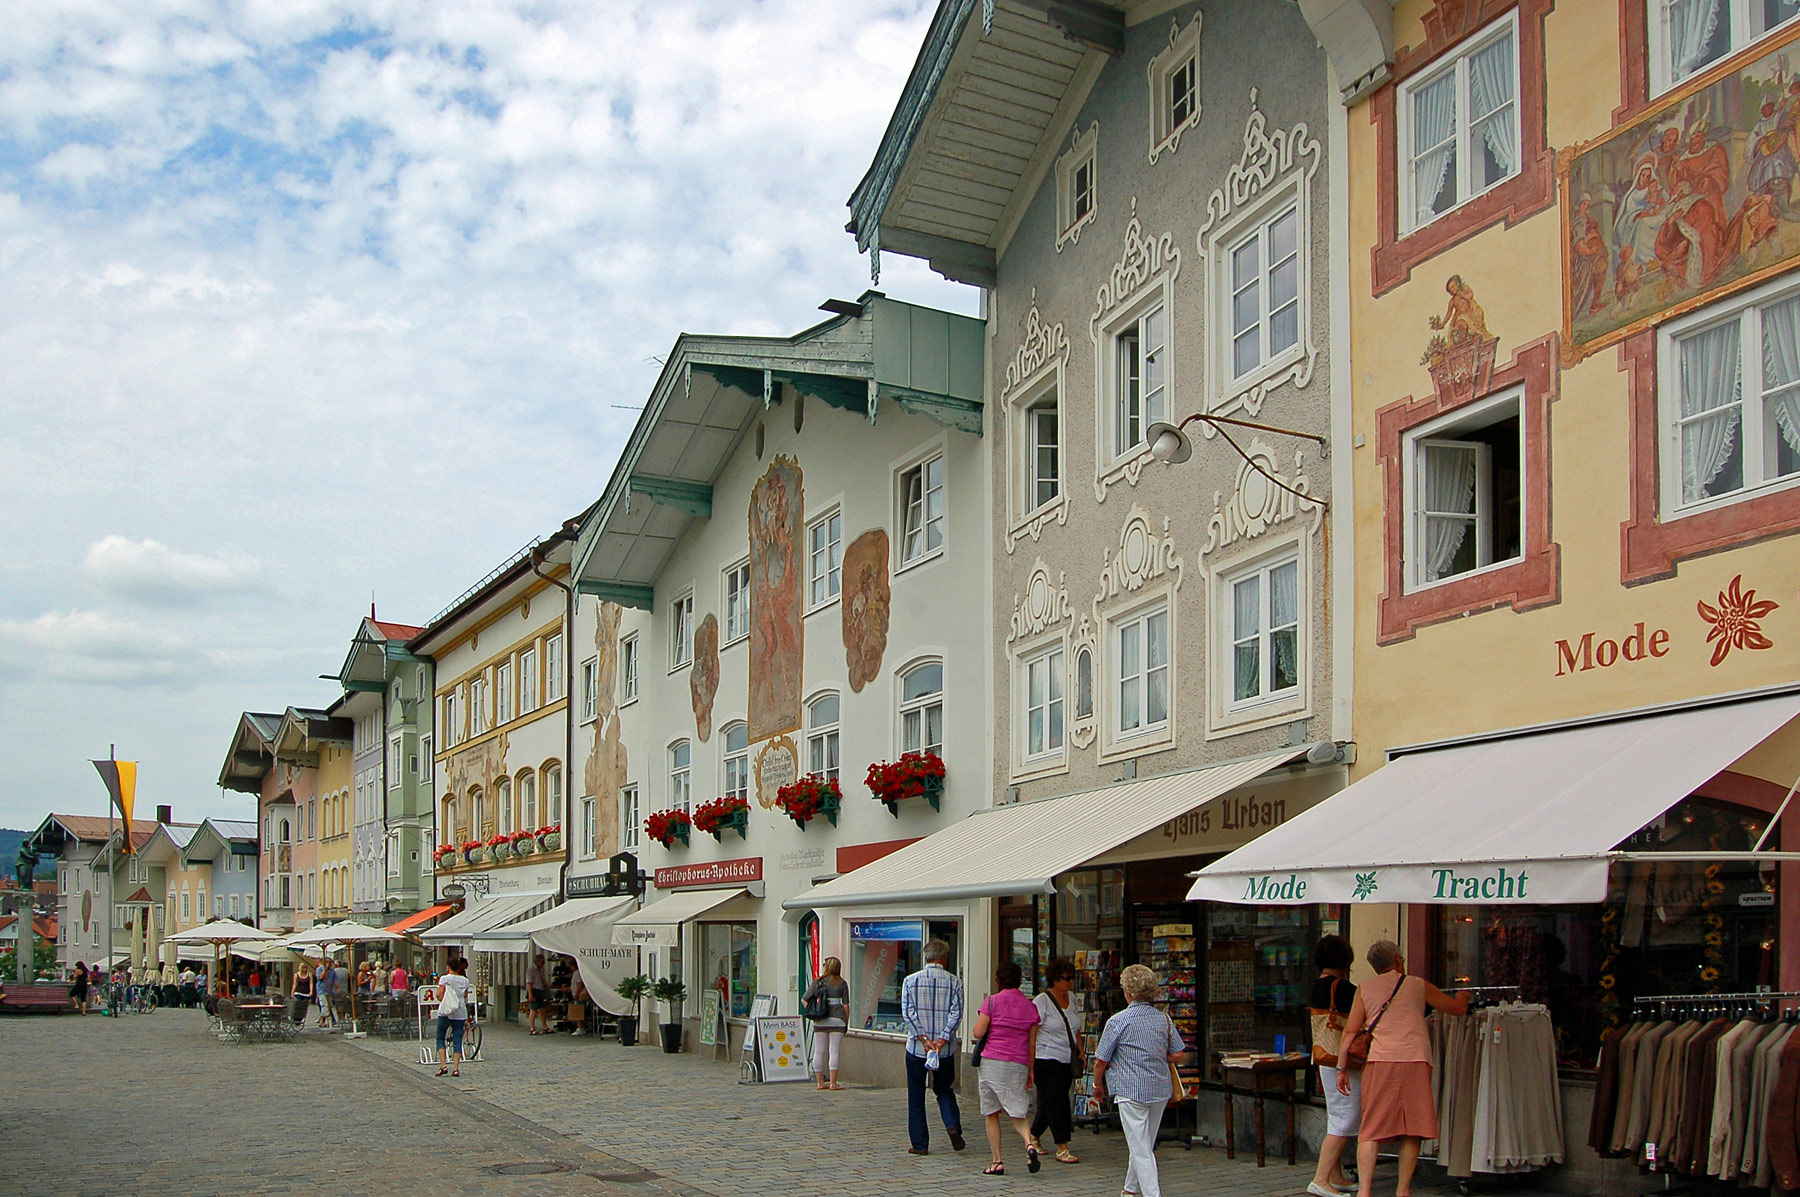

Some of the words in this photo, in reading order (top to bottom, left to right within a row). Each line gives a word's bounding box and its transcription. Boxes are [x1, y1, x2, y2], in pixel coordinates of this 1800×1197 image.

[1555, 621, 1670, 677] Mode
[1221, 795, 1286, 830] Urban
[1241, 874, 1308, 900] Mode
[1431, 868, 1530, 899] Tracht
[579, 947, 632, 958] SCHUH-MAYR
[601, 960, 611, 970] 19
[763, 1021, 780, 1029] Mein
